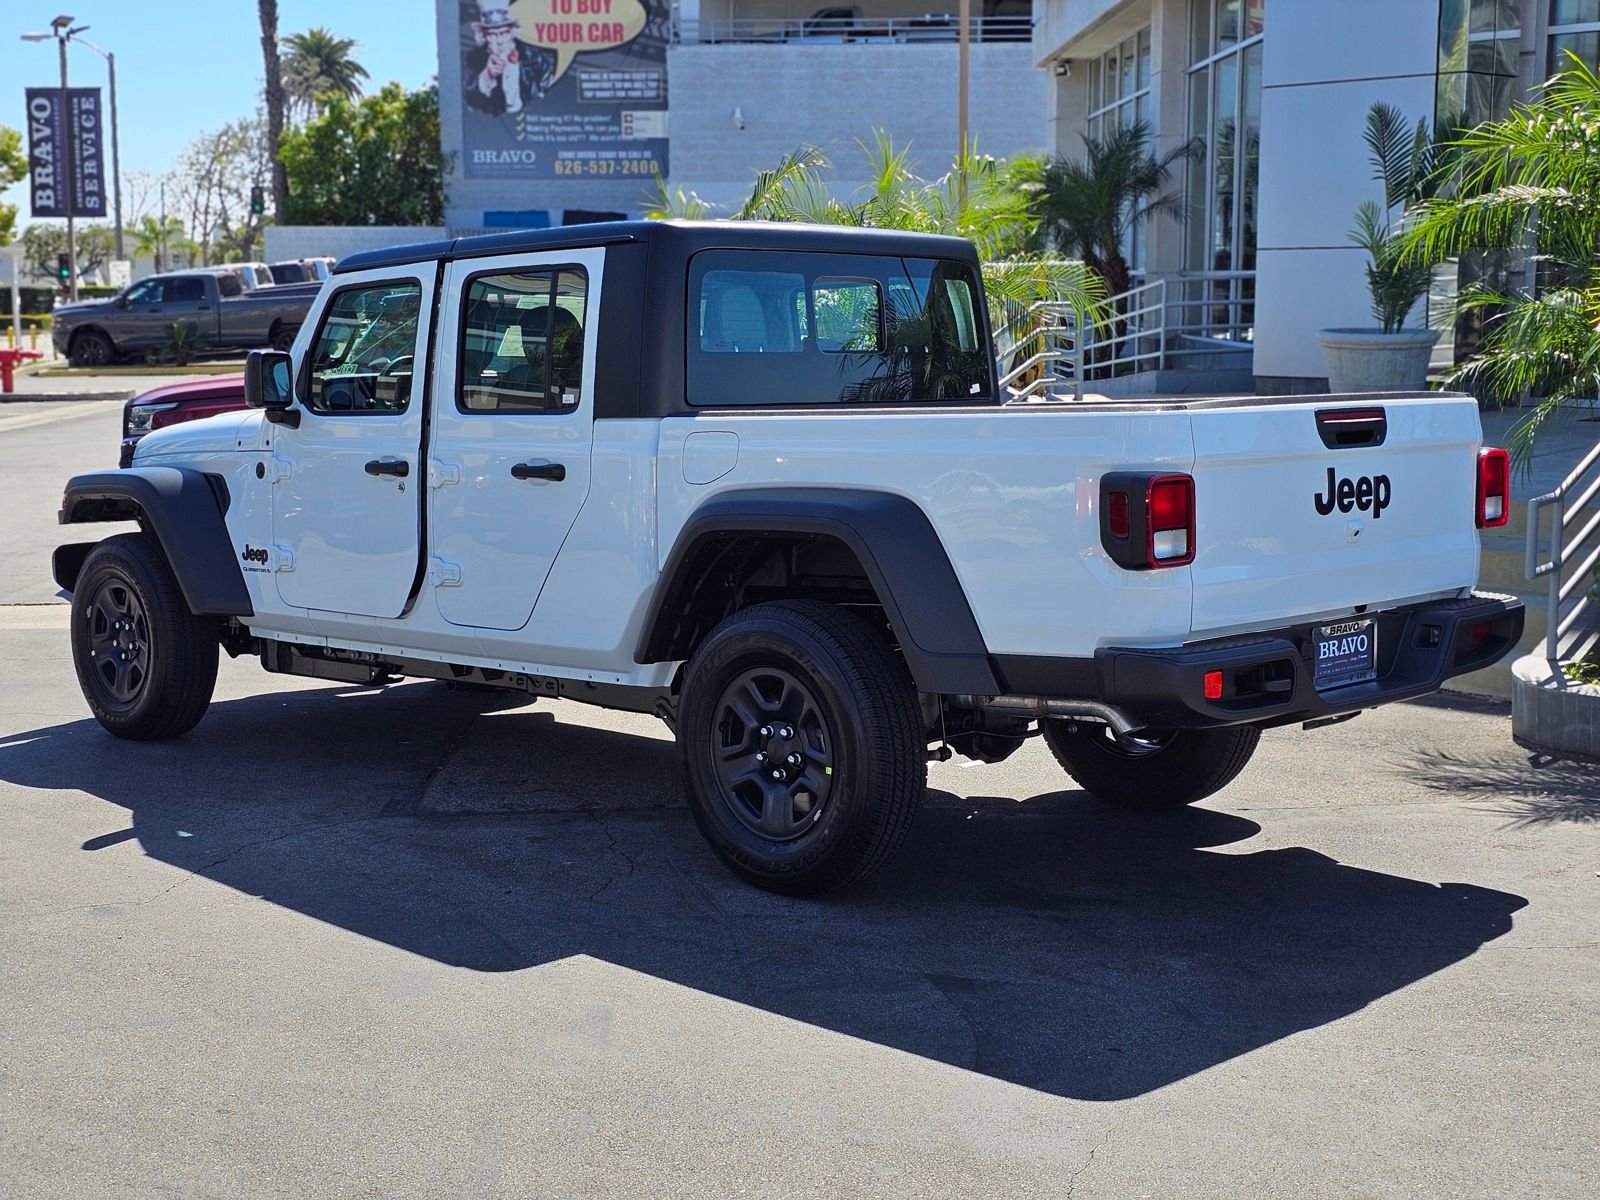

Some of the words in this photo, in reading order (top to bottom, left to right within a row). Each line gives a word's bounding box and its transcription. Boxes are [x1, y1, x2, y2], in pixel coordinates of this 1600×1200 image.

[551, 0, 572, 15] TO
[577, 0, 612, 15] BUY
[535, 22, 583, 43] YOUR
[588, 22, 624, 43] CAR
[31, 97, 54, 208] BRAVO
[81, 97, 99, 208] SERVICE
[472, 149, 536, 164] BRAVO
[554, 160, 659, 174] 626-537-2400
[1314, 467, 1391, 519] Jeep
[242, 544, 268, 565] Jeep
[1329, 622, 1360, 635] BRAVO
[1319, 634, 1368, 659] BRAVO
